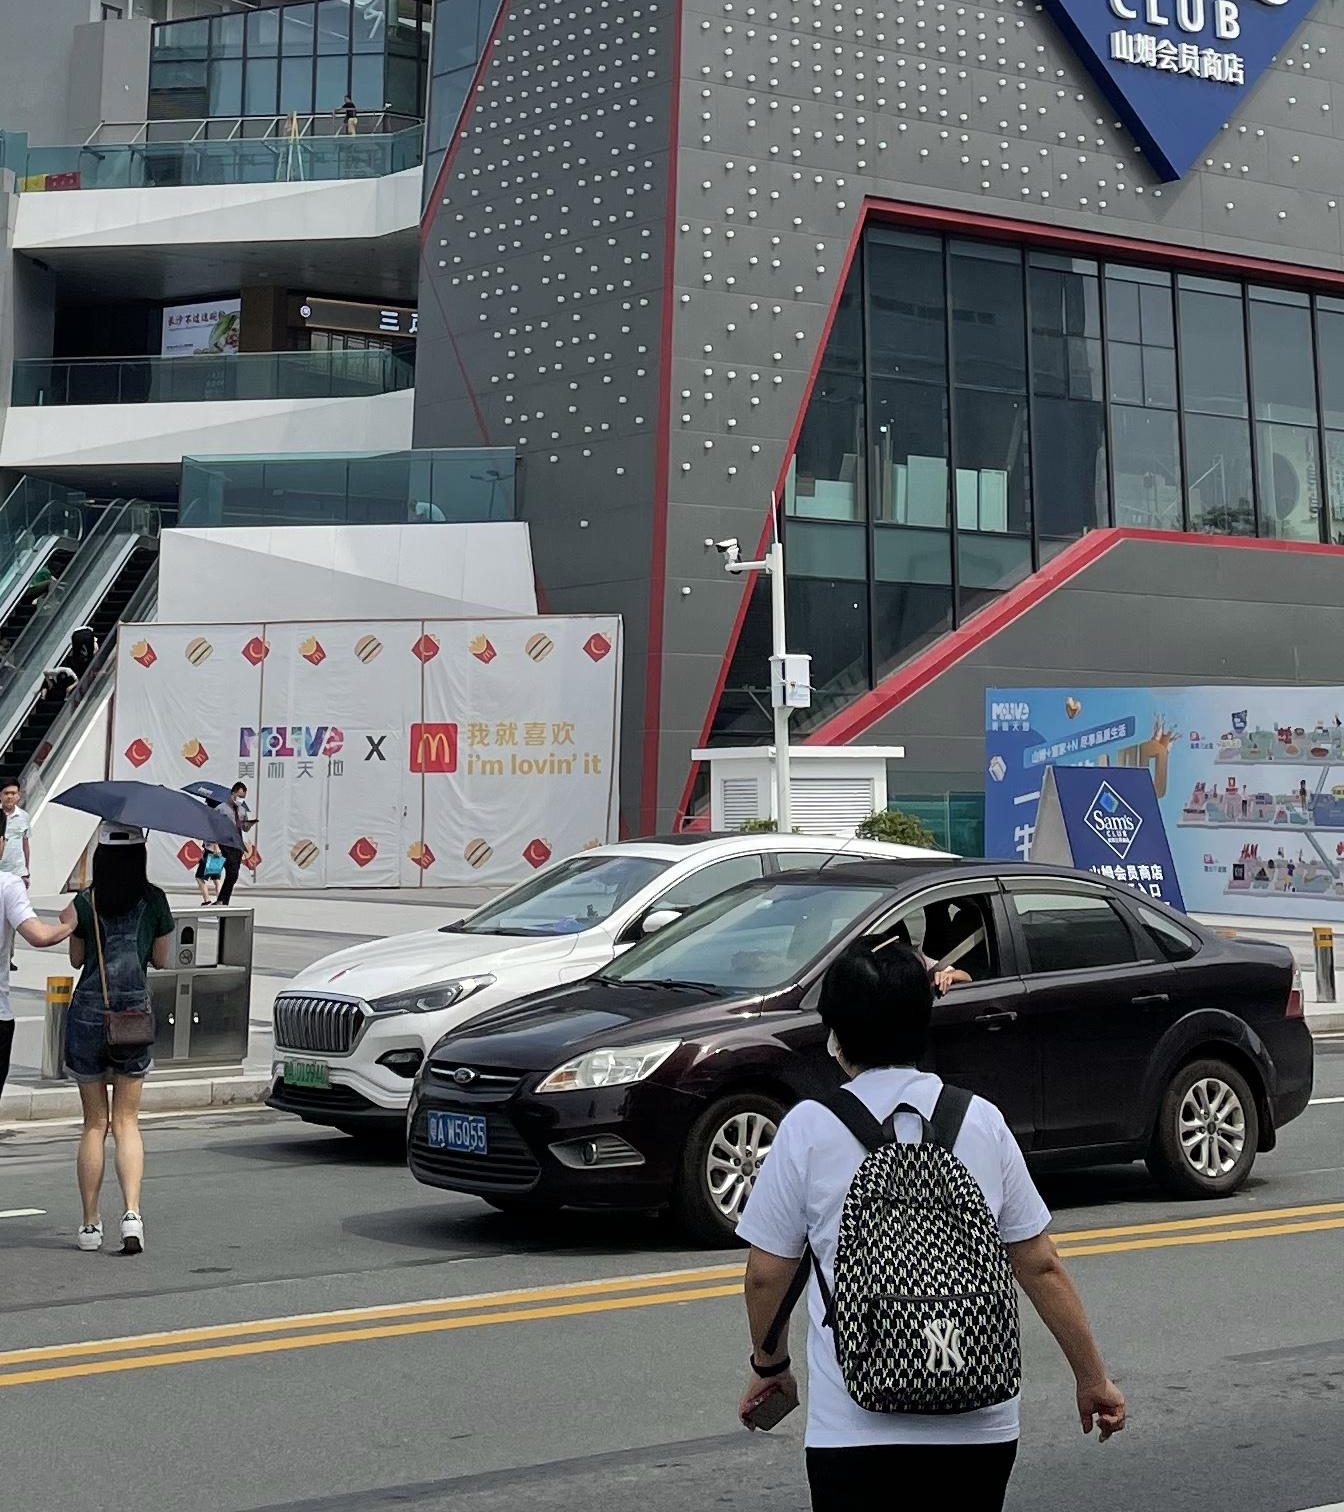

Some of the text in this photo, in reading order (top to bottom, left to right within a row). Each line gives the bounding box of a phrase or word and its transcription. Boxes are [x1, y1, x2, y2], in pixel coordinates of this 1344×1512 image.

[1109, 29, 1245, 85] 山姆会员商店
[467, 722, 576, 747] 我就喜欢
[467, 752, 602, 775] i'm lovin' it
[1093, 809, 1135, 830] Sam's
